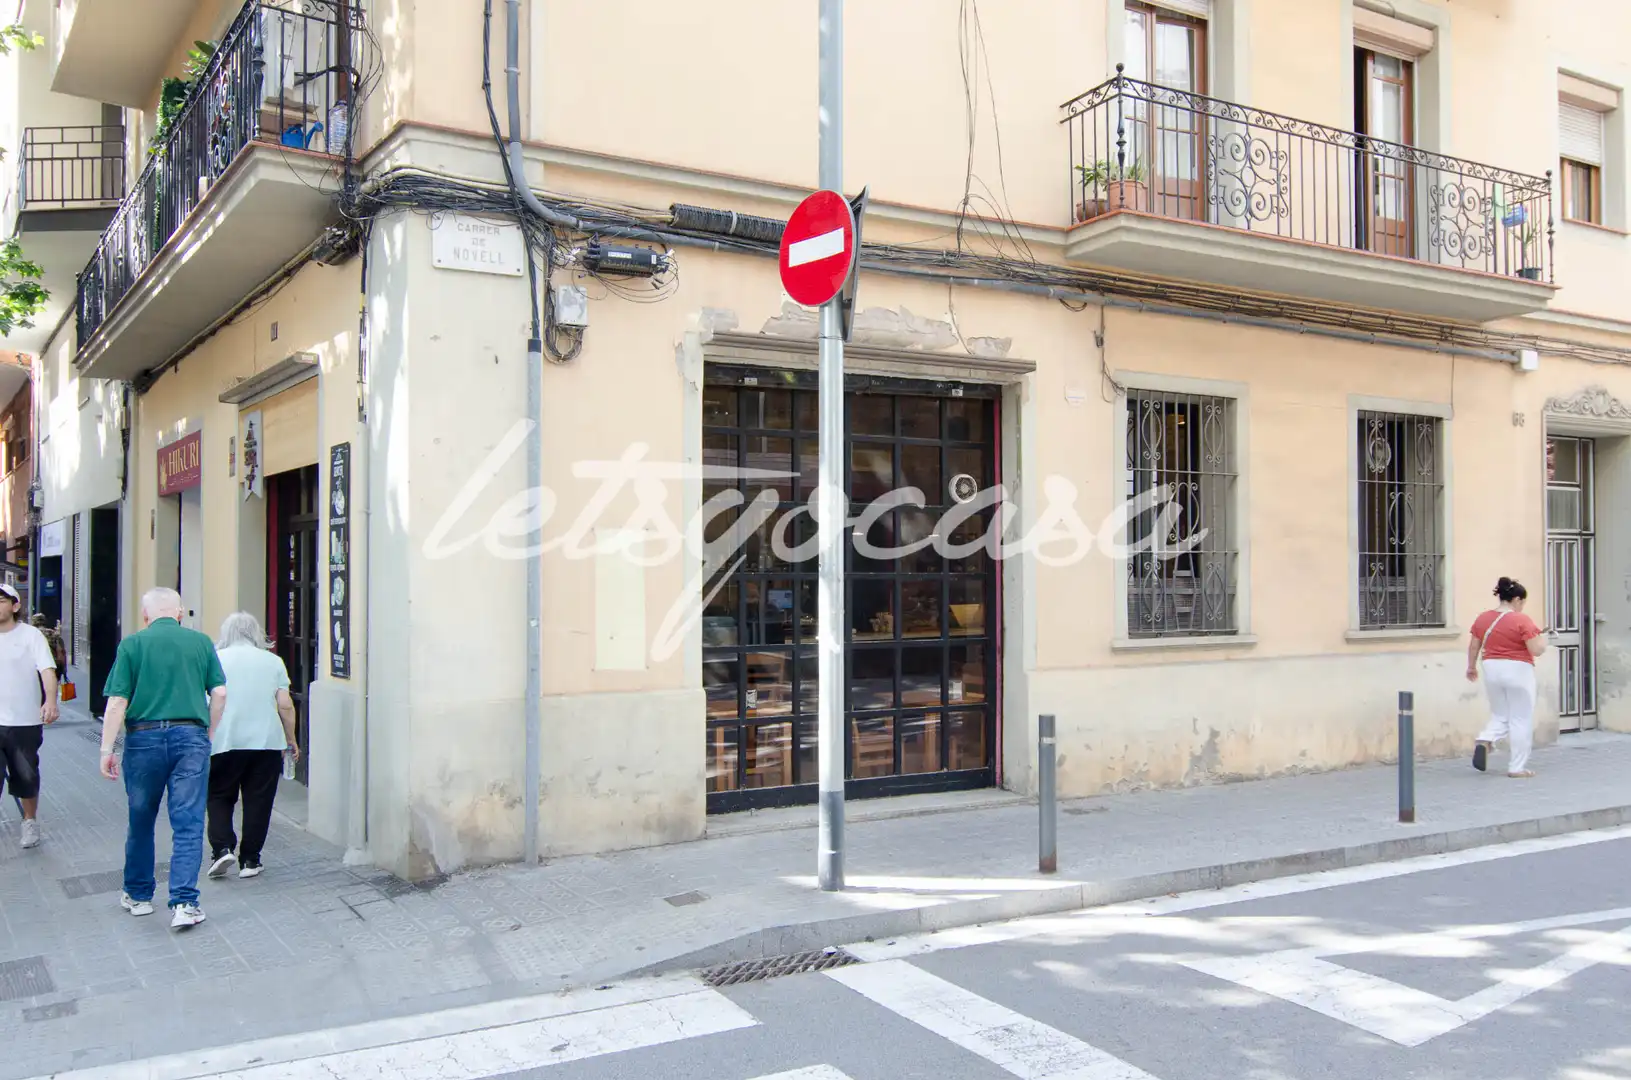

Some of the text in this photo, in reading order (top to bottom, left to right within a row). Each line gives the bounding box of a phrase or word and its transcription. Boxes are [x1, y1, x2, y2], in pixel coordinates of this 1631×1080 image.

[457, 222, 501, 236] CARRER
[472, 237, 487, 247] DE
[453, 246, 505, 265] NOVELL
[168, 440, 199, 477] HIKURI
